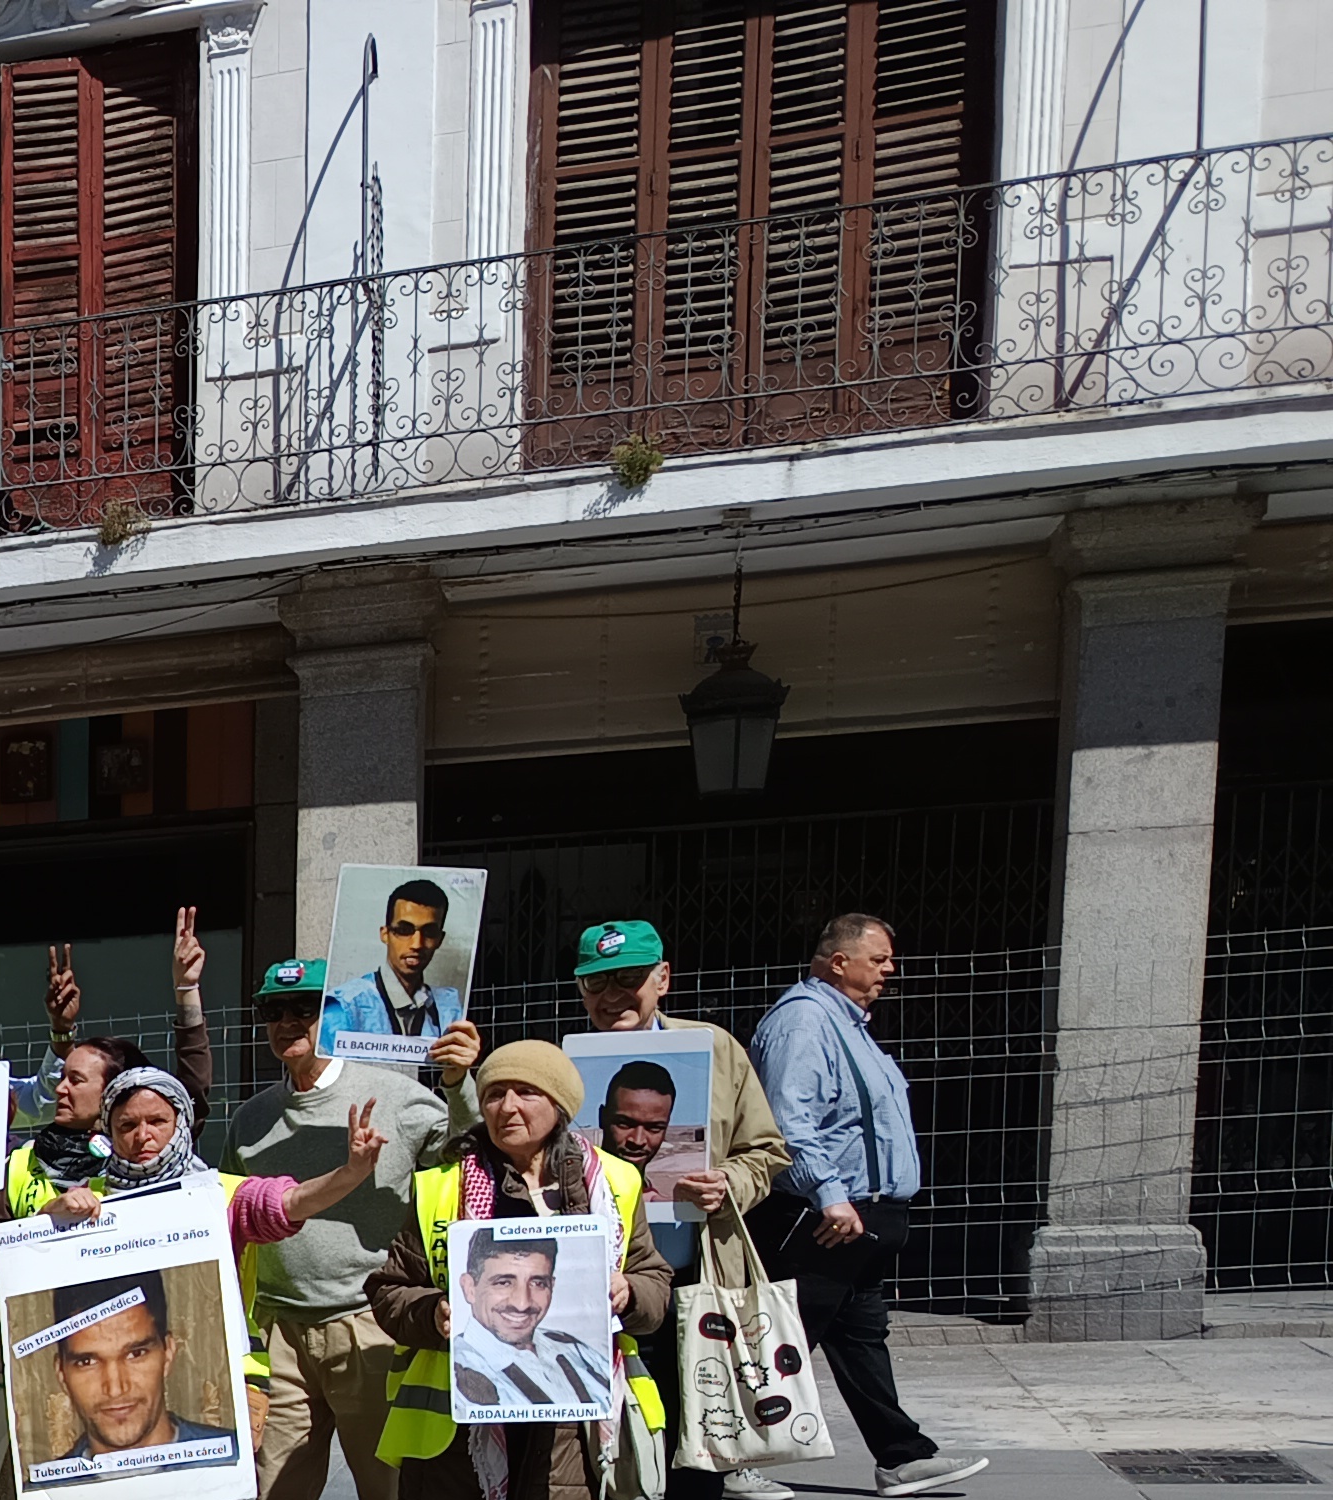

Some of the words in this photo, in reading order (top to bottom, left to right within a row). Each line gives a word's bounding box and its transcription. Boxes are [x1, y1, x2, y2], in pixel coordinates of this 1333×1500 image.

[337, 1040, 348, 1049] EL
[350, 1041, 389, 1052] BACHIR
[500, 1225, 542, 1235] Cadena
[545, 1224, 598, 1234] perpetua
[81, 1245, 111, 1257] Preso
[115, 1237, 156, 1253] político
[166, 1233, 180, 1242] 10
[182, 1229, 210, 1240] años
[17, 1340, 33, 1354] Sin
[35, 1311, 98, 1346] tratamiento
[100, 1292, 139, 1316] médico
[469, 1410, 528, 1419] ABDALAHI
[532, 1408, 598, 1418] LEKHFAUNI
[117, 1452, 166, 1467] adquirida
[168, 1451, 182, 1459] en
[184, 1449, 193, 1458] la
[196, 1444, 227, 1456] cárcel
